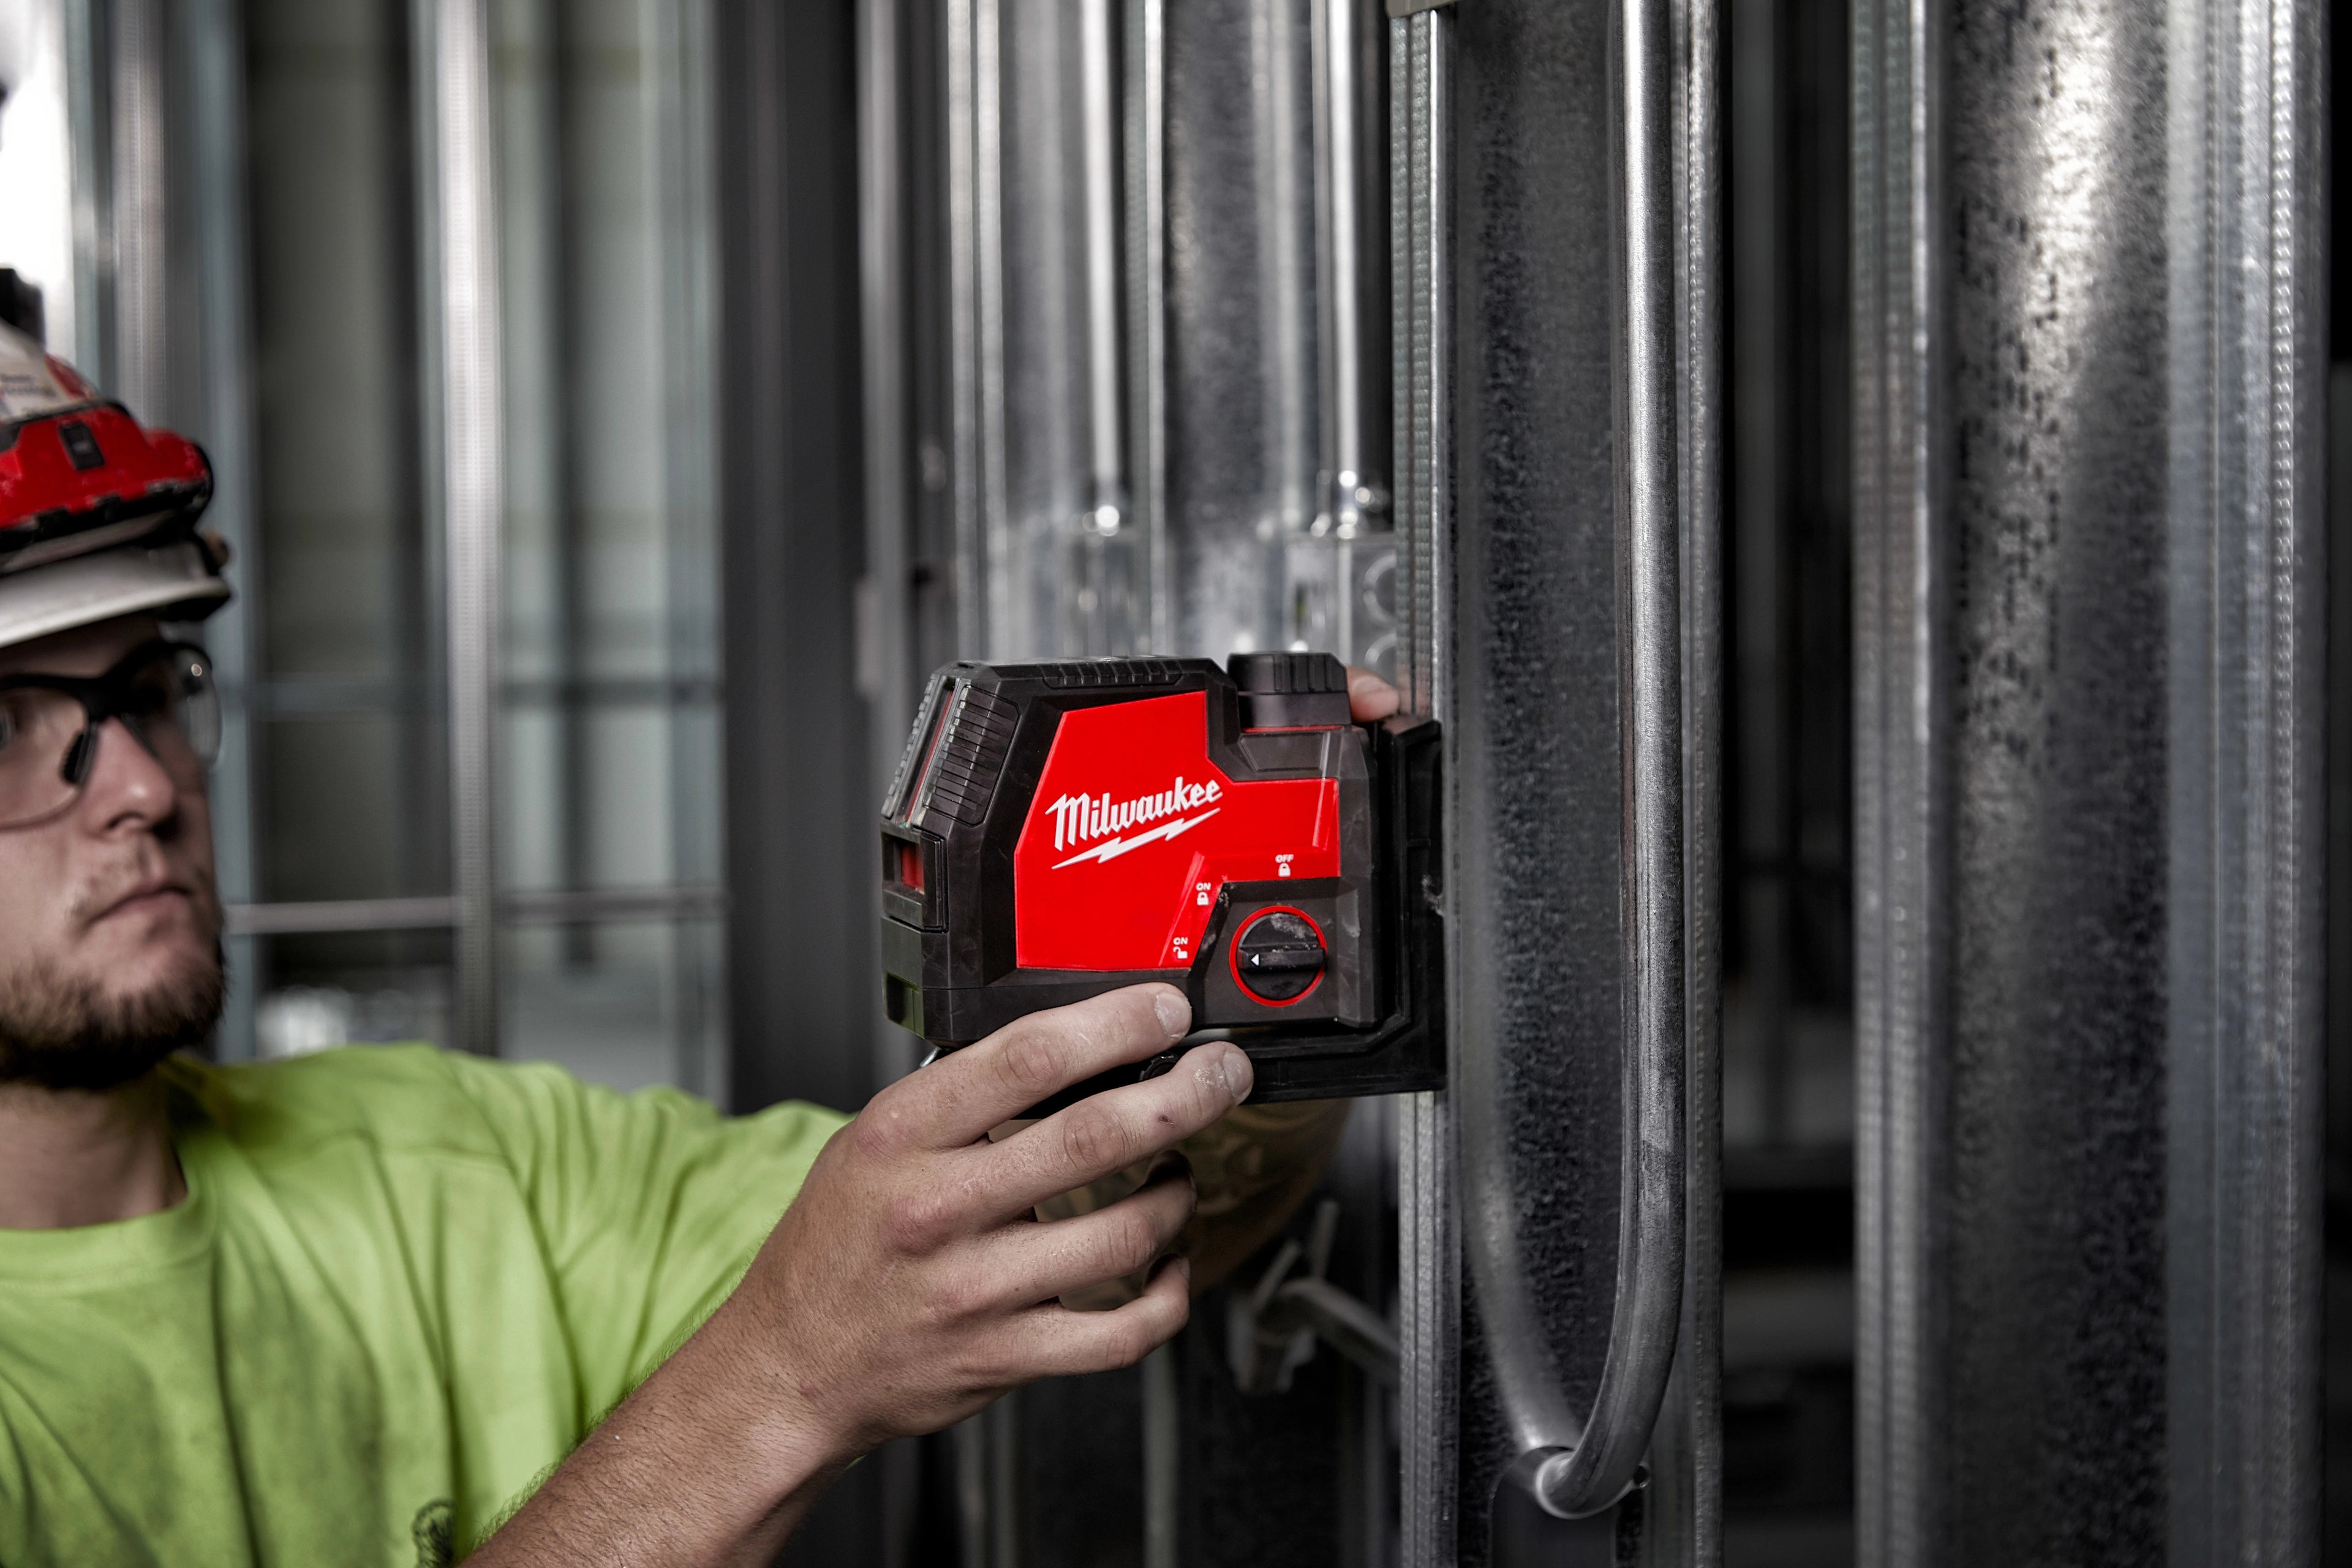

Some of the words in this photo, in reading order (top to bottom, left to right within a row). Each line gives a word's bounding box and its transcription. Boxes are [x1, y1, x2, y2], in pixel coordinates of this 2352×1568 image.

[1044, 776, 1223, 851] Milwaukee
[1275, 854, 1294, 863] OFF
[1196, 882, 1212, 891] ON
[1173, 937, 1188, 946] ON
